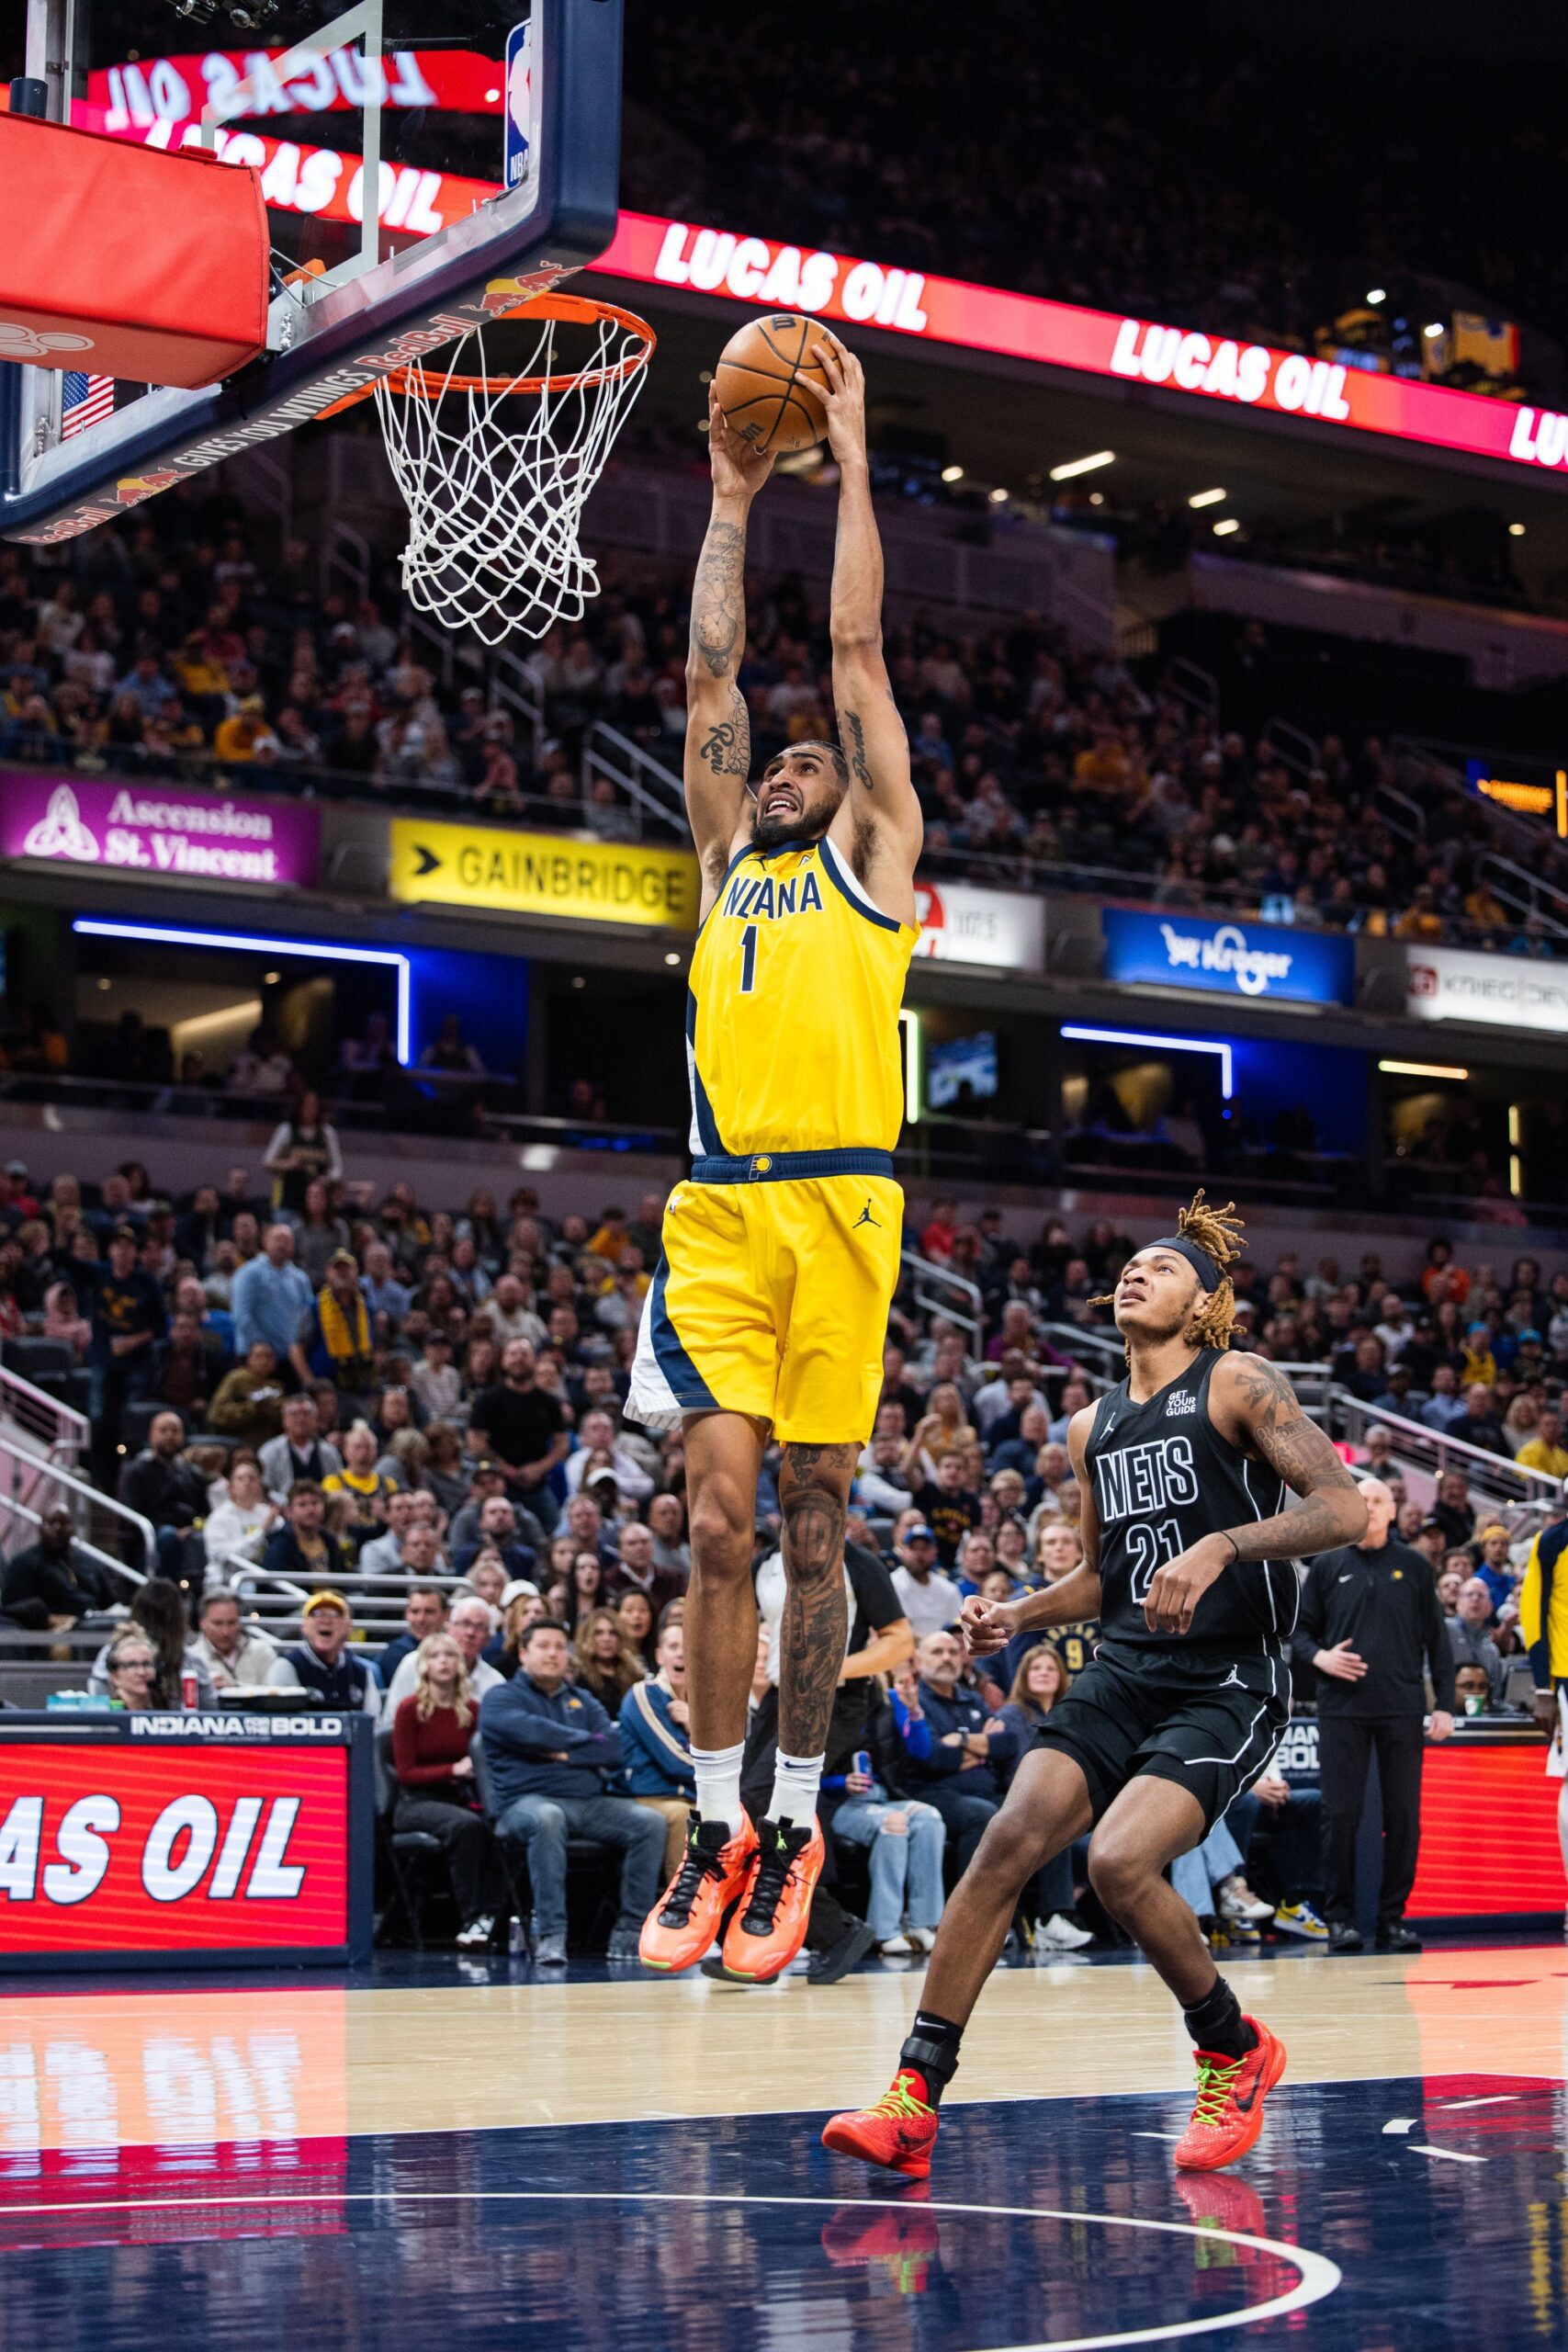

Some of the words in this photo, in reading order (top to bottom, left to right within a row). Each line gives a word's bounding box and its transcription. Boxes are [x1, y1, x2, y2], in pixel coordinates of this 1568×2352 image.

[346, 159, 445, 233] OIL
[654, 222, 839, 312] LUCAS
[840, 261, 928, 332] OIL
[1110, 319, 1271, 403] LUCAS
[1274, 354, 1350, 421] OIL
[173, 436, 250, 467] GIVES
[232, 418, 294, 442] YOU
[107, 789, 274, 841] Ascension
[150, 831, 278, 881] Vincent
[457, 845, 683, 912] GAINBRIDGE
[739, 922, 759, 994] 1
[1201, 924, 1293, 996] Kroger
[1166, 1404, 1197, 1417] GUIDE
[1168, 1389, 1189, 1400] GET
[1168, 1396, 1196, 1408] YOUR
[1095, 1435, 1200, 1522] NETS
[1066, 1637, 1084, 1671] 9
[130, 1716, 245, 1736] INDIANA
[271, 1717, 343, 1736] BOLD
[141, 1793, 308, 1904] OIL
